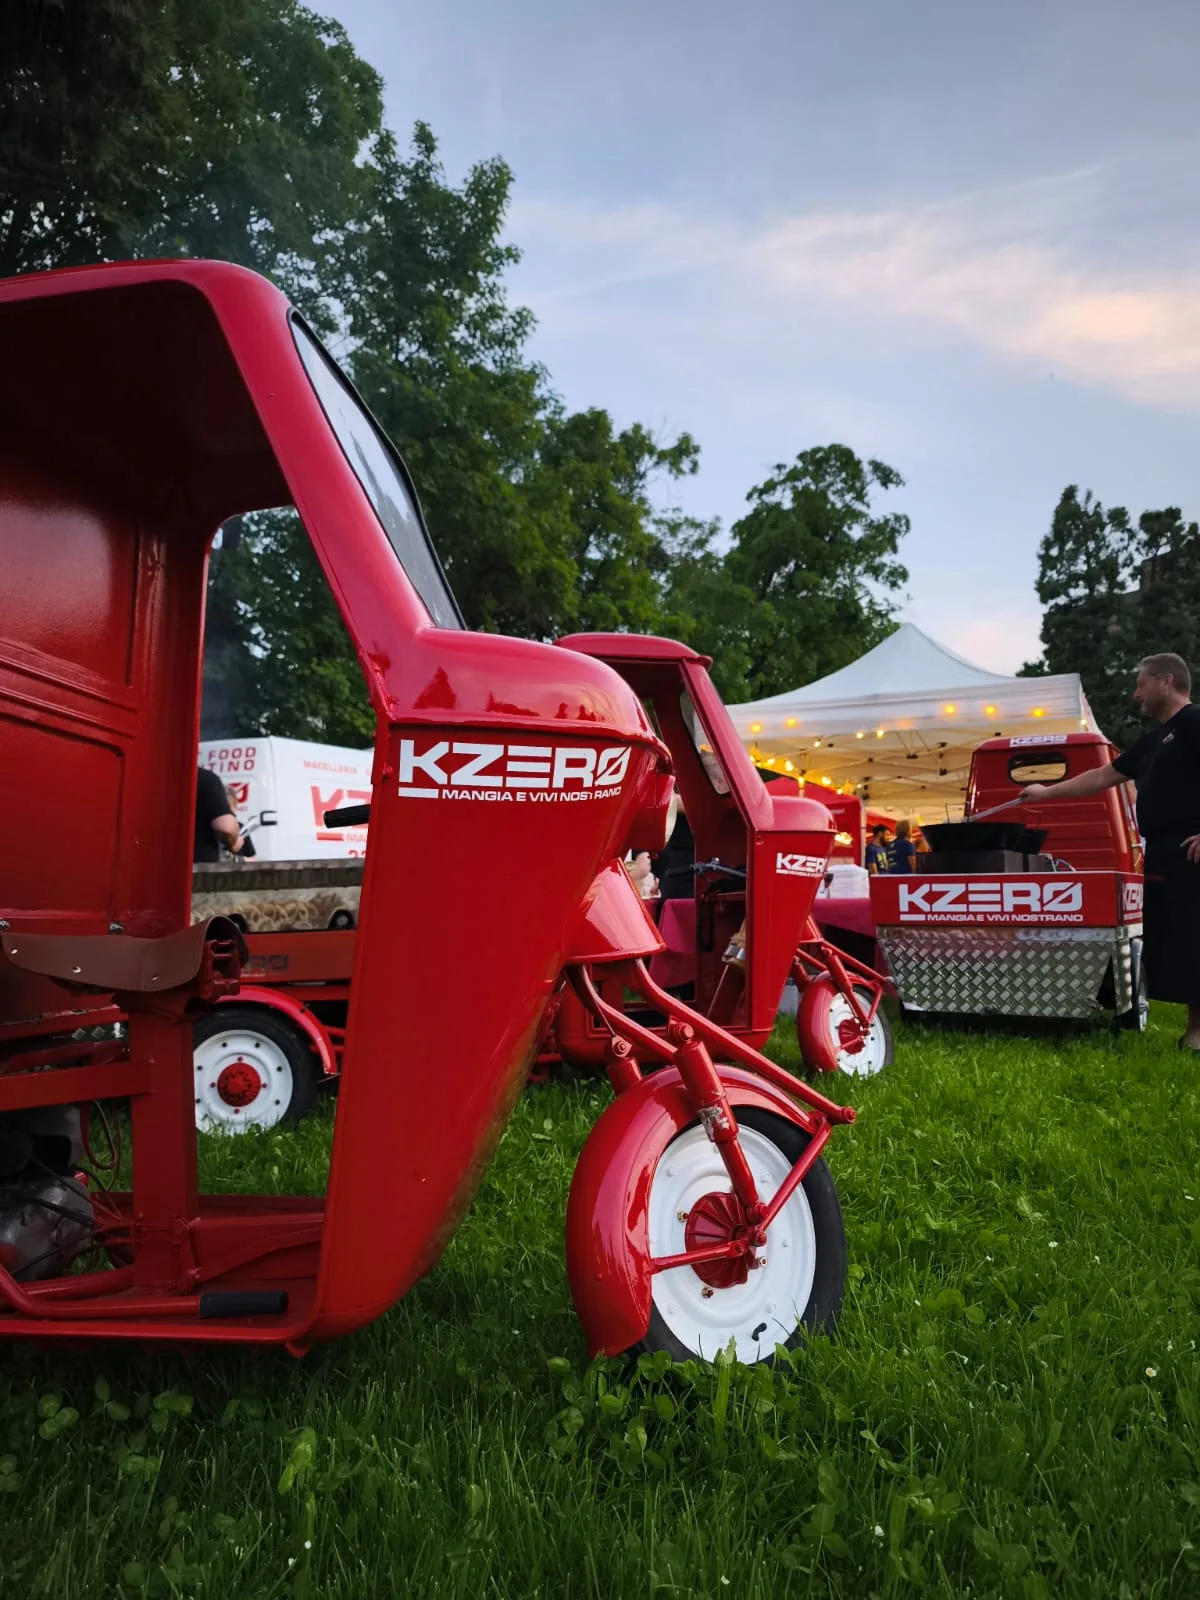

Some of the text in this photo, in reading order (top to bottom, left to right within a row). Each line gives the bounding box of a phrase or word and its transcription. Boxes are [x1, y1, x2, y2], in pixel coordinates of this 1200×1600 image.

[208, 747, 256, 761] FOOD
[442, 789, 512, 802] MANGIA
[516, 791, 527, 802] E
[529, 792, 558, 802] VIVI
[927, 914, 976, 922] MANGIA
[986, 914, 1009, 922] VIVI
[1012, 914, 1083, 922] NOSTRANO
